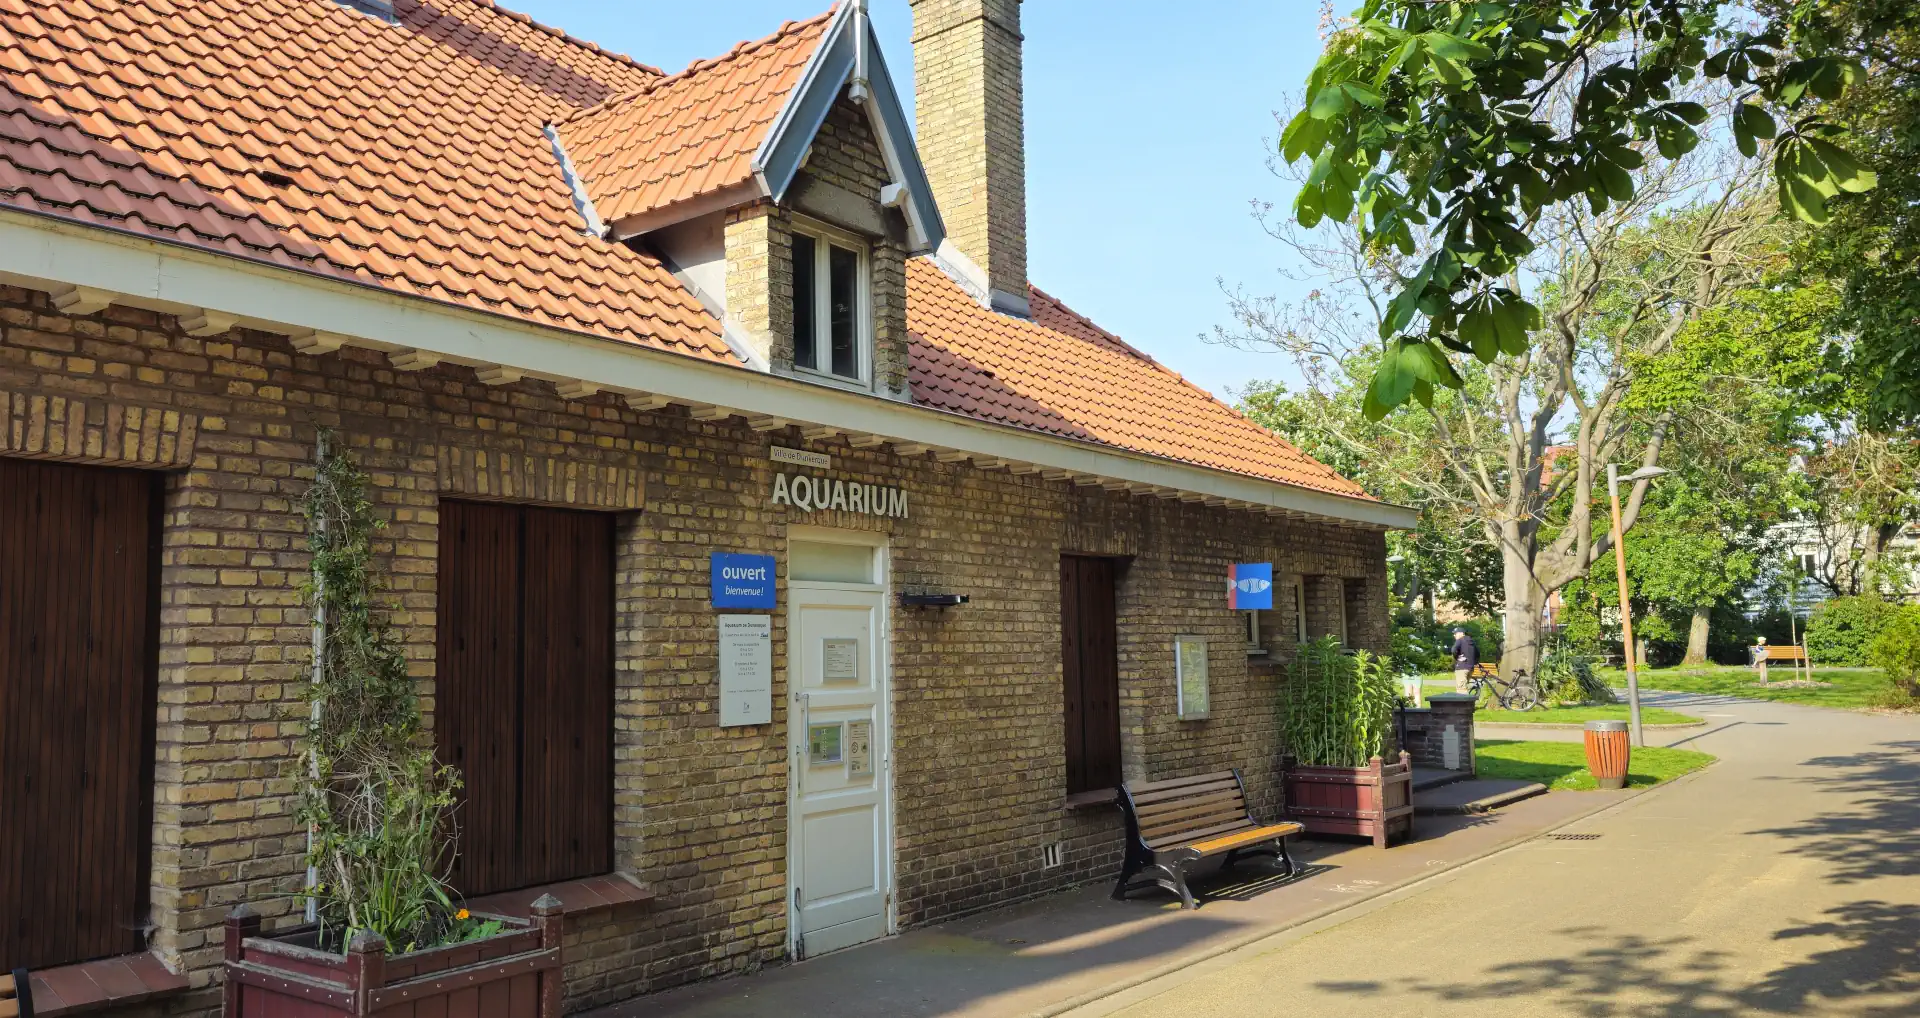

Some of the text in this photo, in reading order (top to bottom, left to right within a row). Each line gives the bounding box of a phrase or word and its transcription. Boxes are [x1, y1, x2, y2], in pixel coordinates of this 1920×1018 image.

[773, 449, 787, 458] Ville
[796, 453, 828, 465] Dunkerque
[772, 473, 909, 518] AQUARIUM
[722, 566, 766, 580] ouvert
